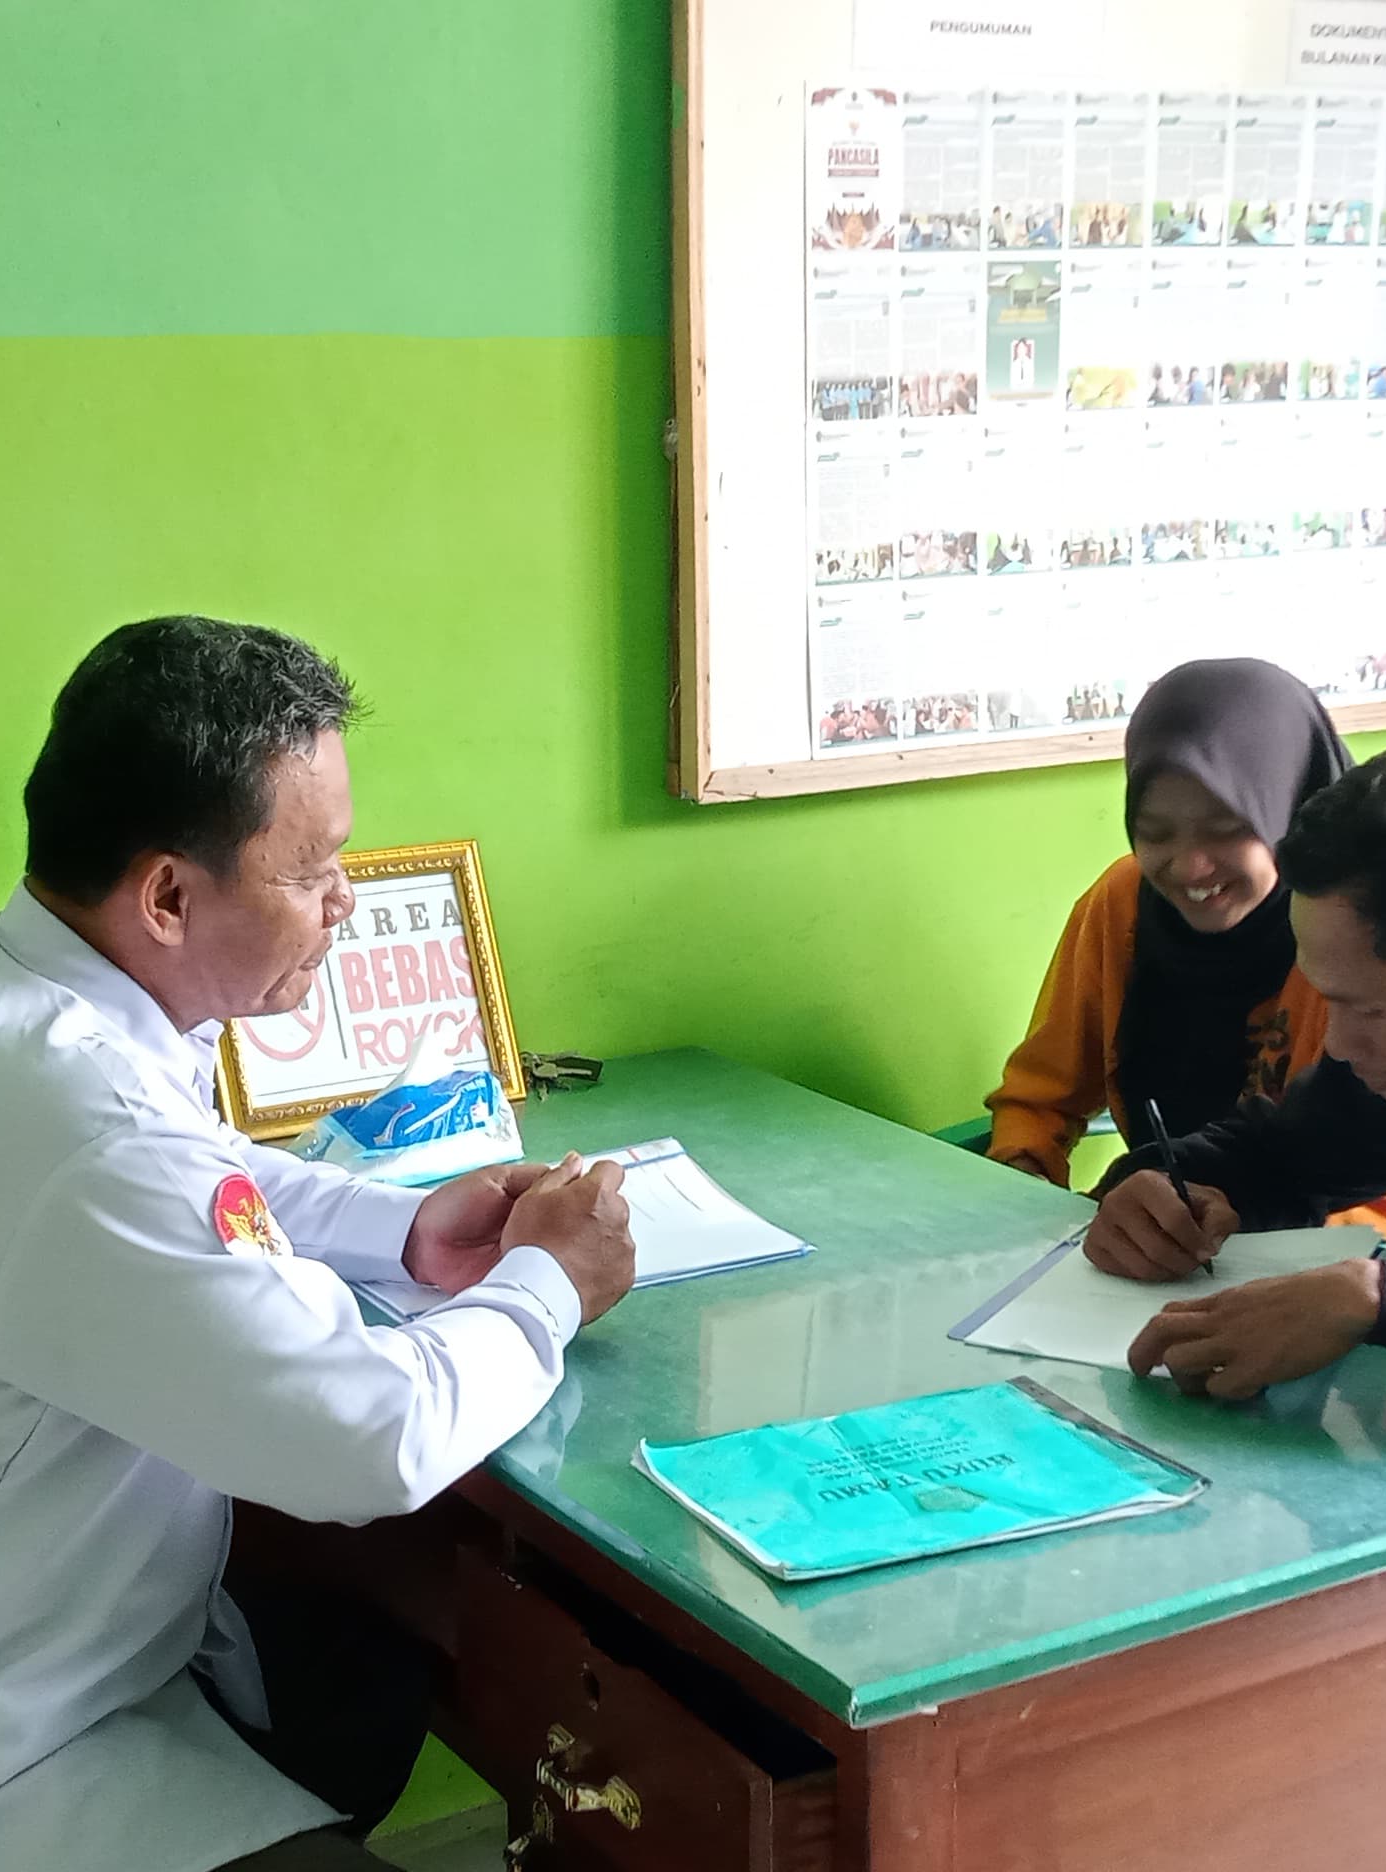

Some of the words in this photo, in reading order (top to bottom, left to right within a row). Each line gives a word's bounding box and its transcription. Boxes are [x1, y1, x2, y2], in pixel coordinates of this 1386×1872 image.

[930, 20, 1032, 35] PENGUMUMAN
[1301, 50, 1370, 65] BULANAN
[828, 148, 879, 166] PANCASILA
[337, 899, 464, 941] AREA
[338, 935, 478, 1014] BEBAS
[920, 1453, 1016, 1483] BUKU
[817, 1475, 918, 1504] TAMU
